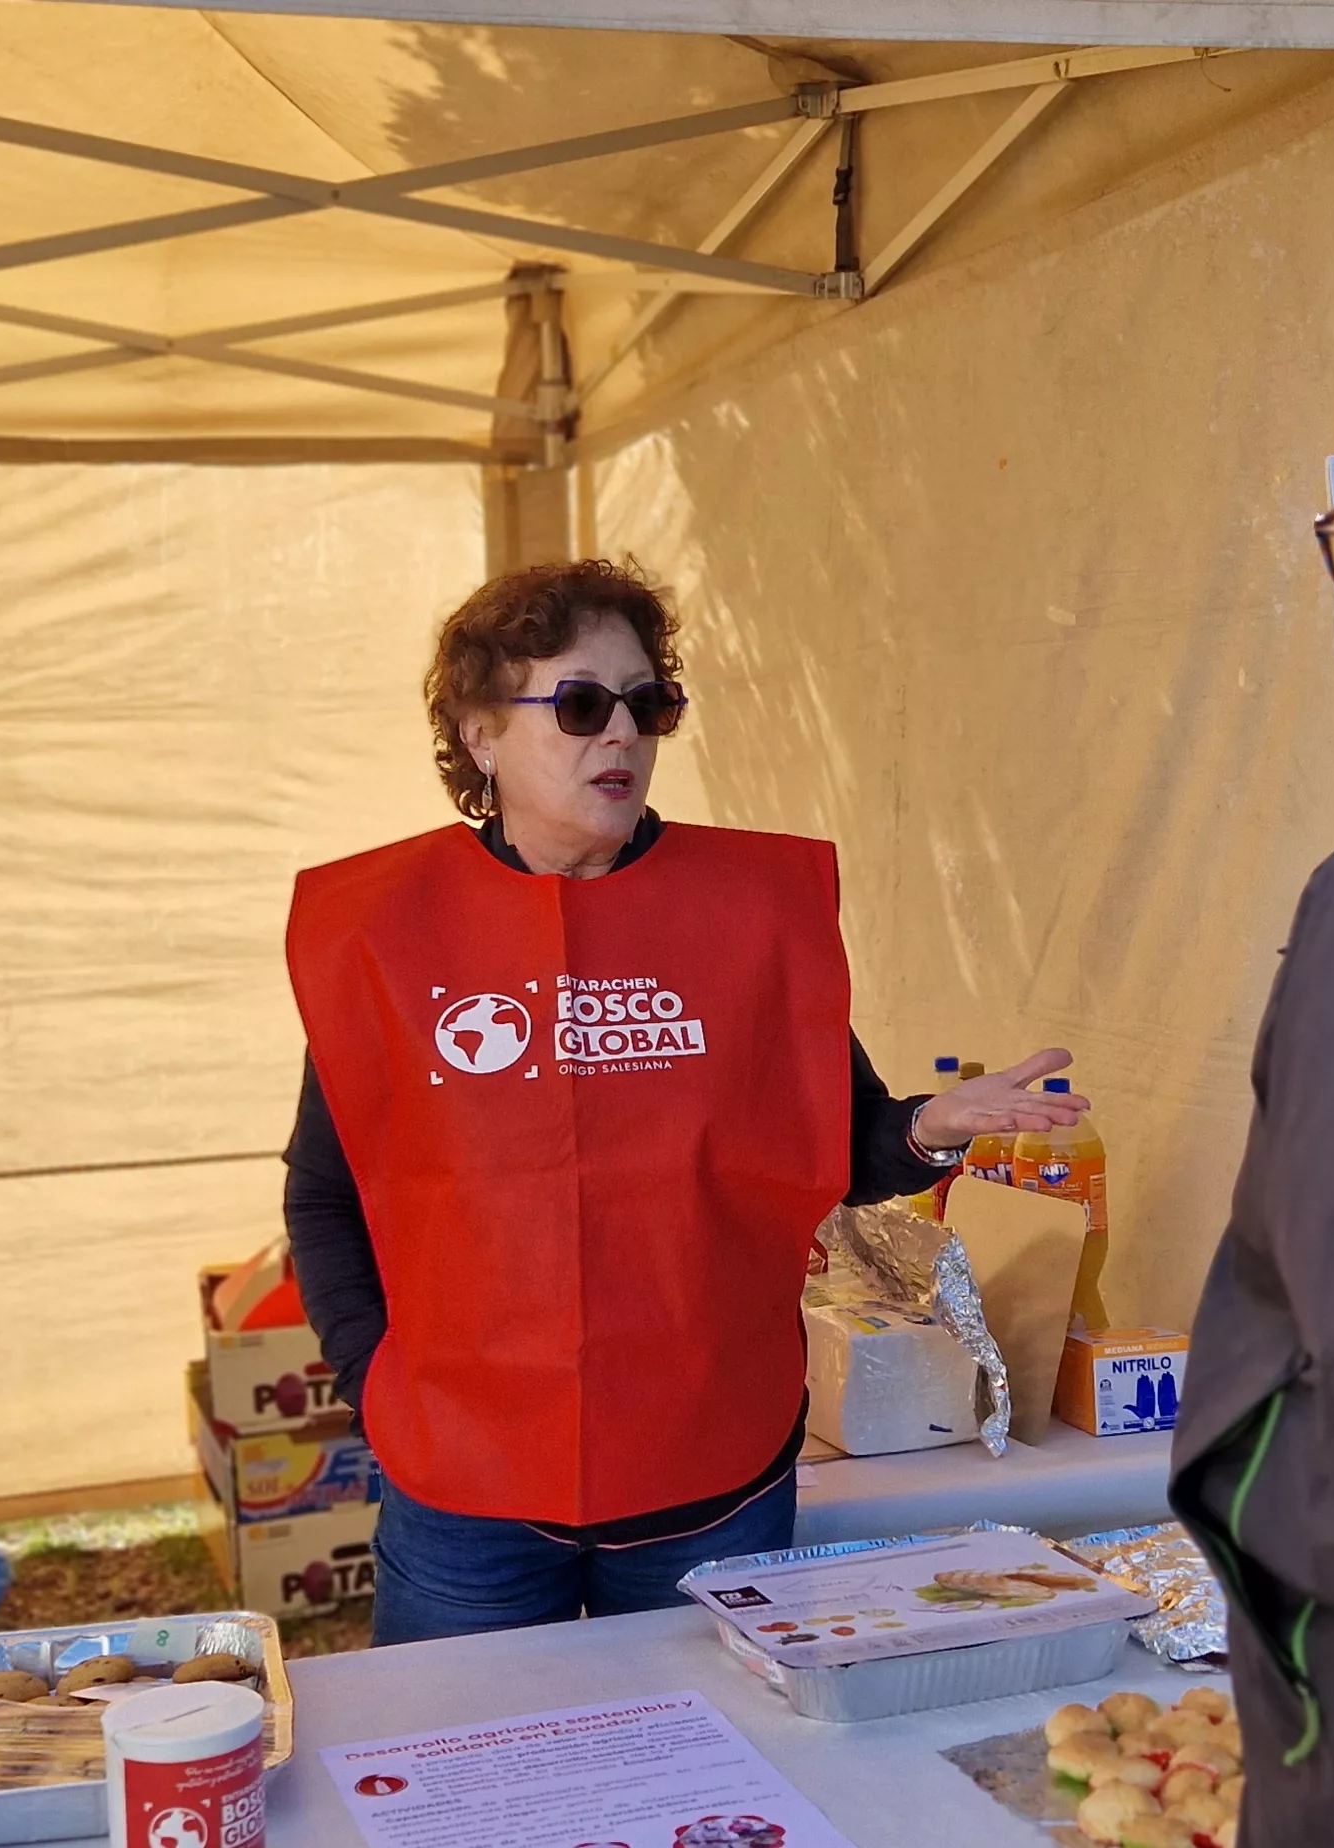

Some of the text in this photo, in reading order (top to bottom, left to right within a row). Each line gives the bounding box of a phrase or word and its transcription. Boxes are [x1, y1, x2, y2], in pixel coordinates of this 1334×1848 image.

[557, 990, 683, 1024] BOSCO
[559, 1023, 700, 1058] GLOBAL
[559, 1060, 673, 1076] ONGD SALESIANA
[1038, 1163, 1070, 1177] FANTA
[1112, 1356, 1172, 1374] NITRILO
[345, 1736, 462, 1761] Desarrollo
[565, 1703, 676, 1725] sostenible
[681, 1700, 693, 1709] y
[415, 1717, 643, 1759] solidario en Ecuador
